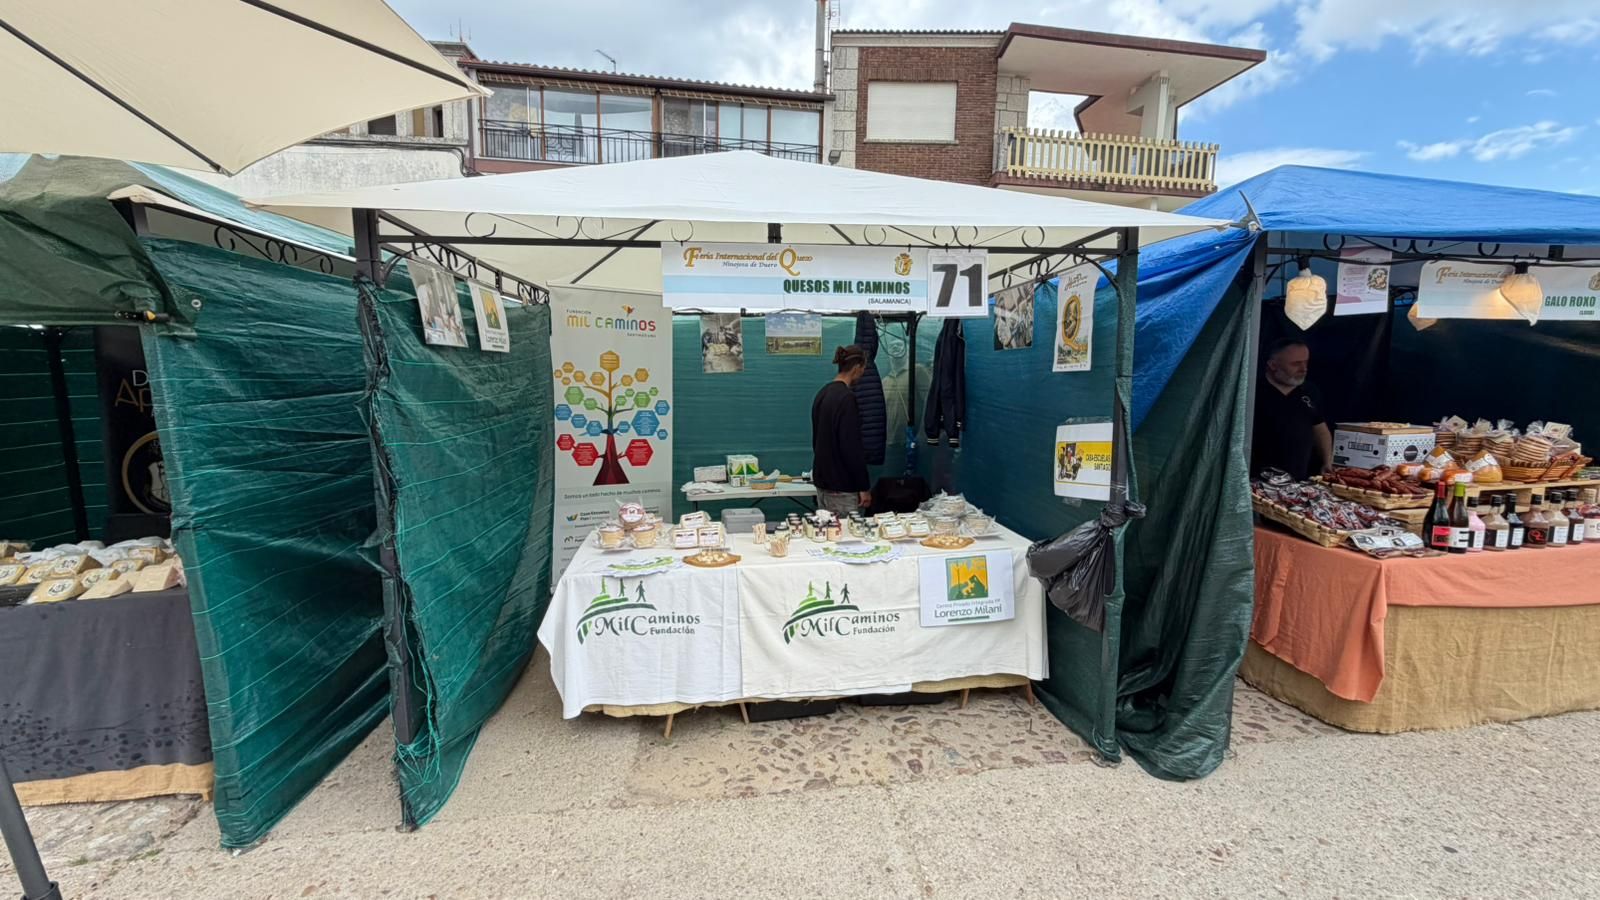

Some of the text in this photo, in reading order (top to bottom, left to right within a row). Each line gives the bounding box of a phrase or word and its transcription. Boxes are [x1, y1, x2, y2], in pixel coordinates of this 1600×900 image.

[715, 252, 765, 260] Internacional
[766, 252, 779, 260] del
[783, 279, 911, 295] QUESOS MIL CAMINOS
[932, 263, 984, 308] 71
[1544, 295, 1597, 307] GALO ROXO
[934, 604, 1003, 618] Lorenzo Milani
[650, 625, 695, 635] Fundación
[853, 626, 895, 635] Fundación
